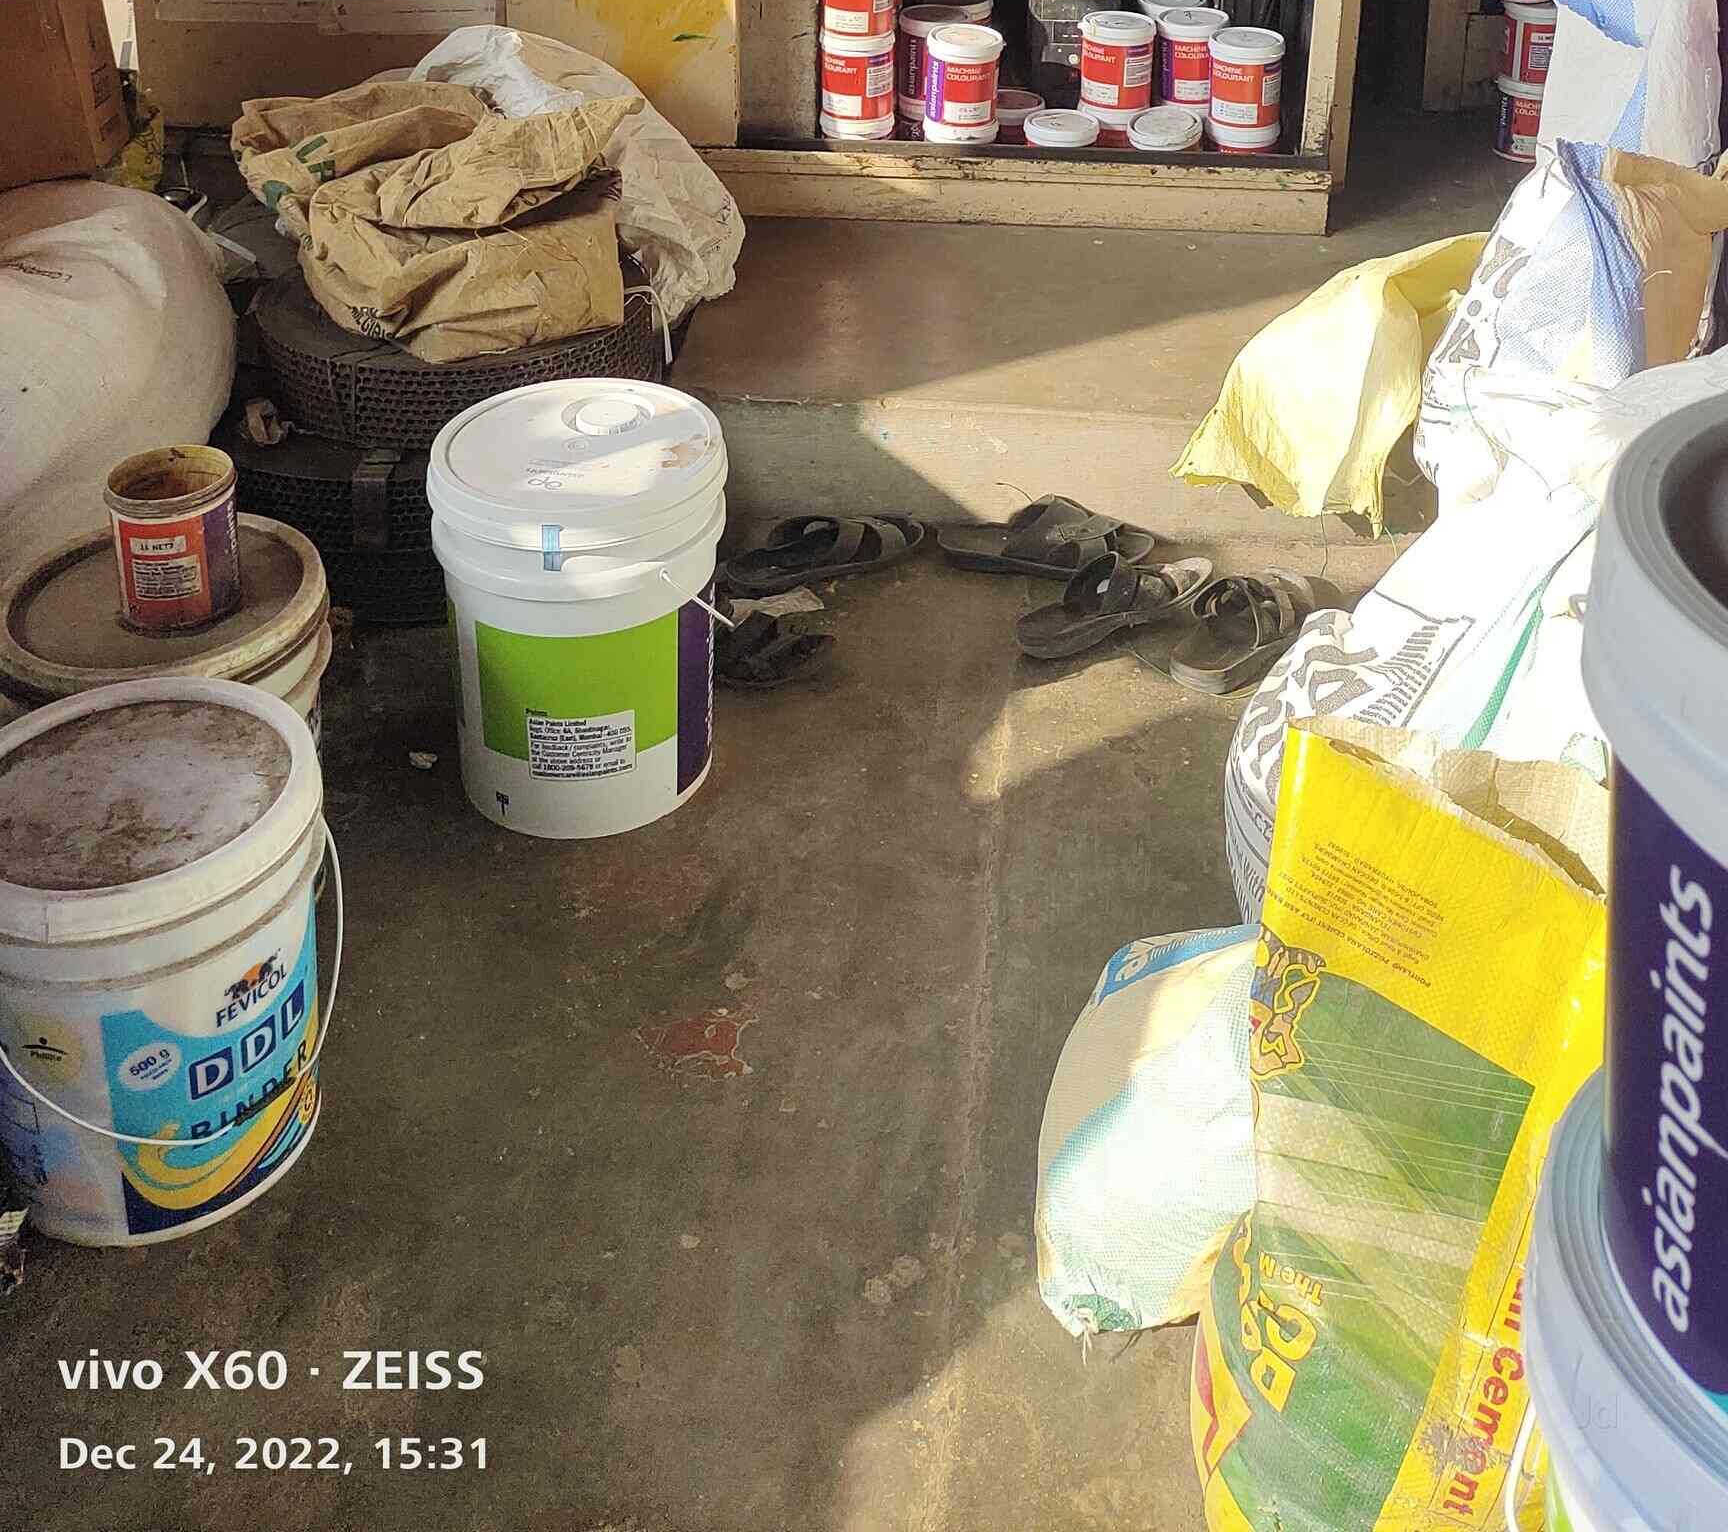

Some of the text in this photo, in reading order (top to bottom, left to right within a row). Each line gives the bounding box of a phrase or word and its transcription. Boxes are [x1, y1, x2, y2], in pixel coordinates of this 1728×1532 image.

[215, 963, 288, 1029] FEVICOL
[129, 1056, 157, 1077] 500
[197, 990, 304, 1096] DDL
[1645, 864, 1728, 1334] asianpaints
